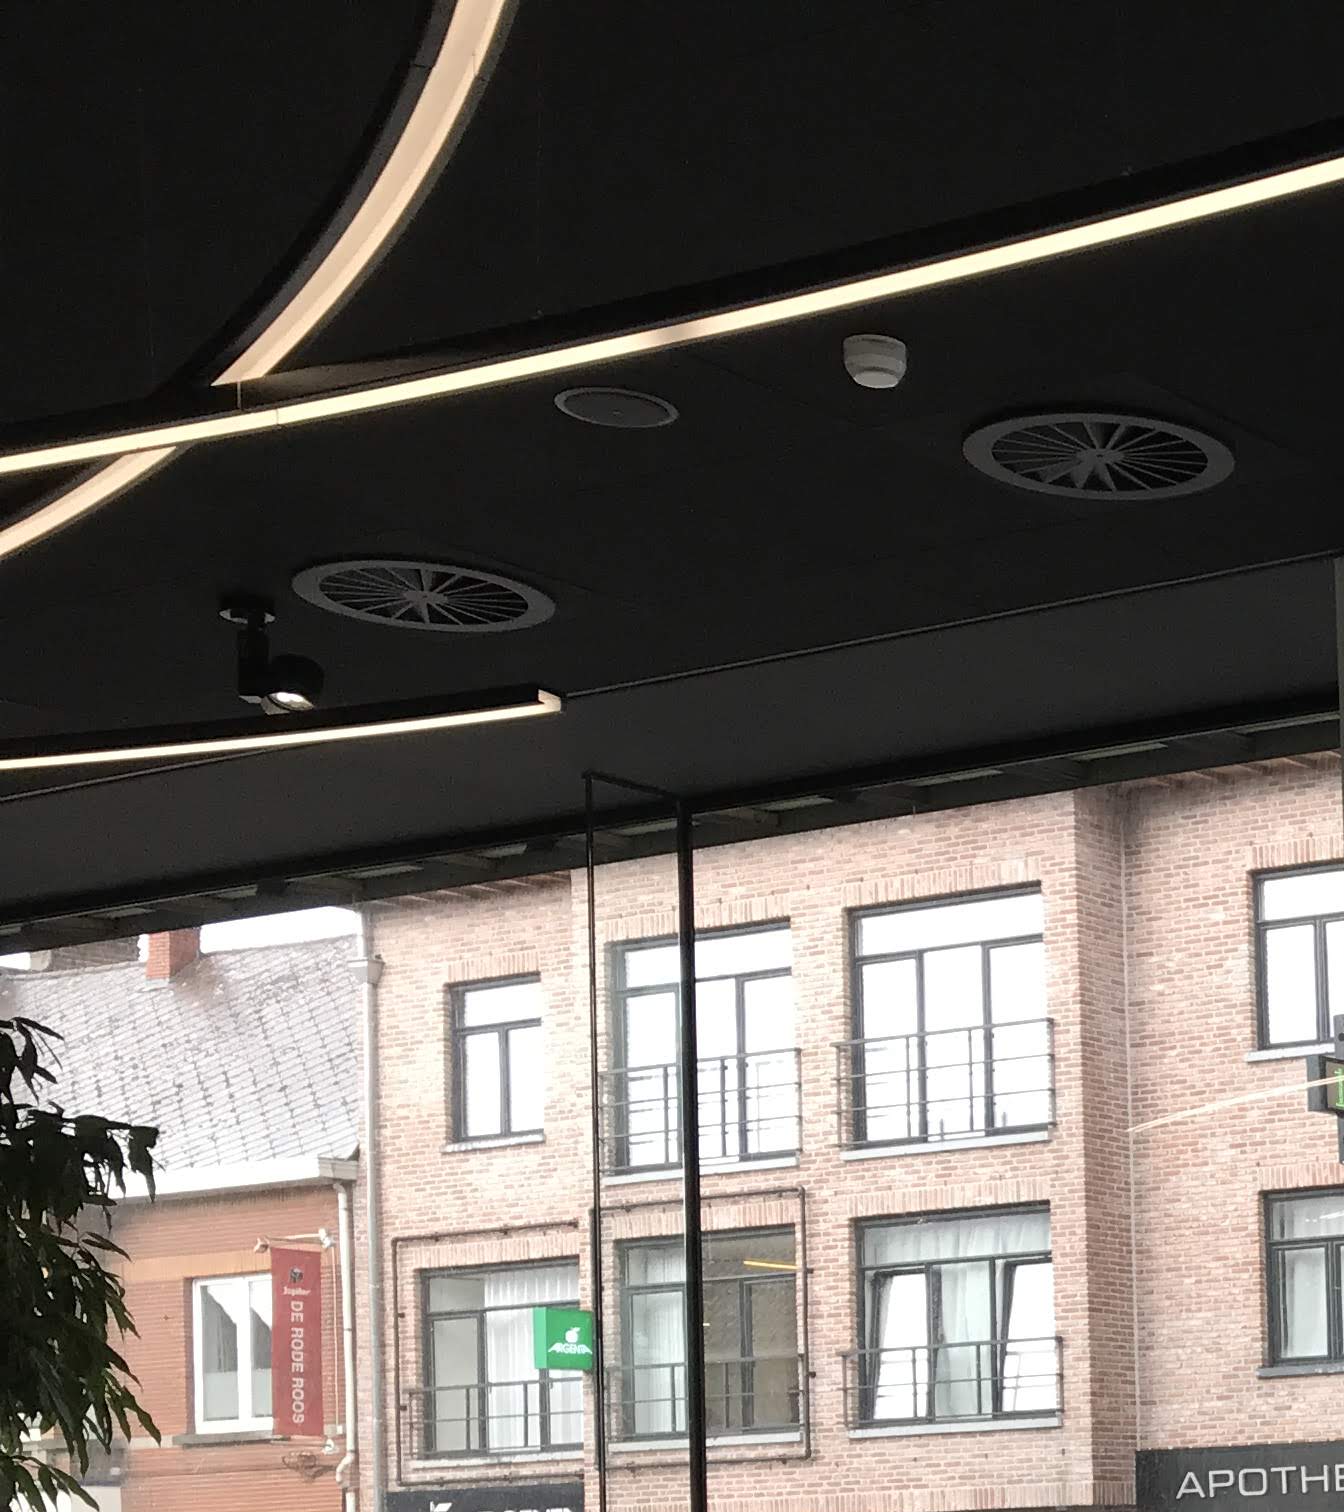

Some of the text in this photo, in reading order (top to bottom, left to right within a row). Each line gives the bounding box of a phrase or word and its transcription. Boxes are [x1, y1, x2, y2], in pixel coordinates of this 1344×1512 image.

[291, 1301, 305, 1424] DE RODE ROOS
